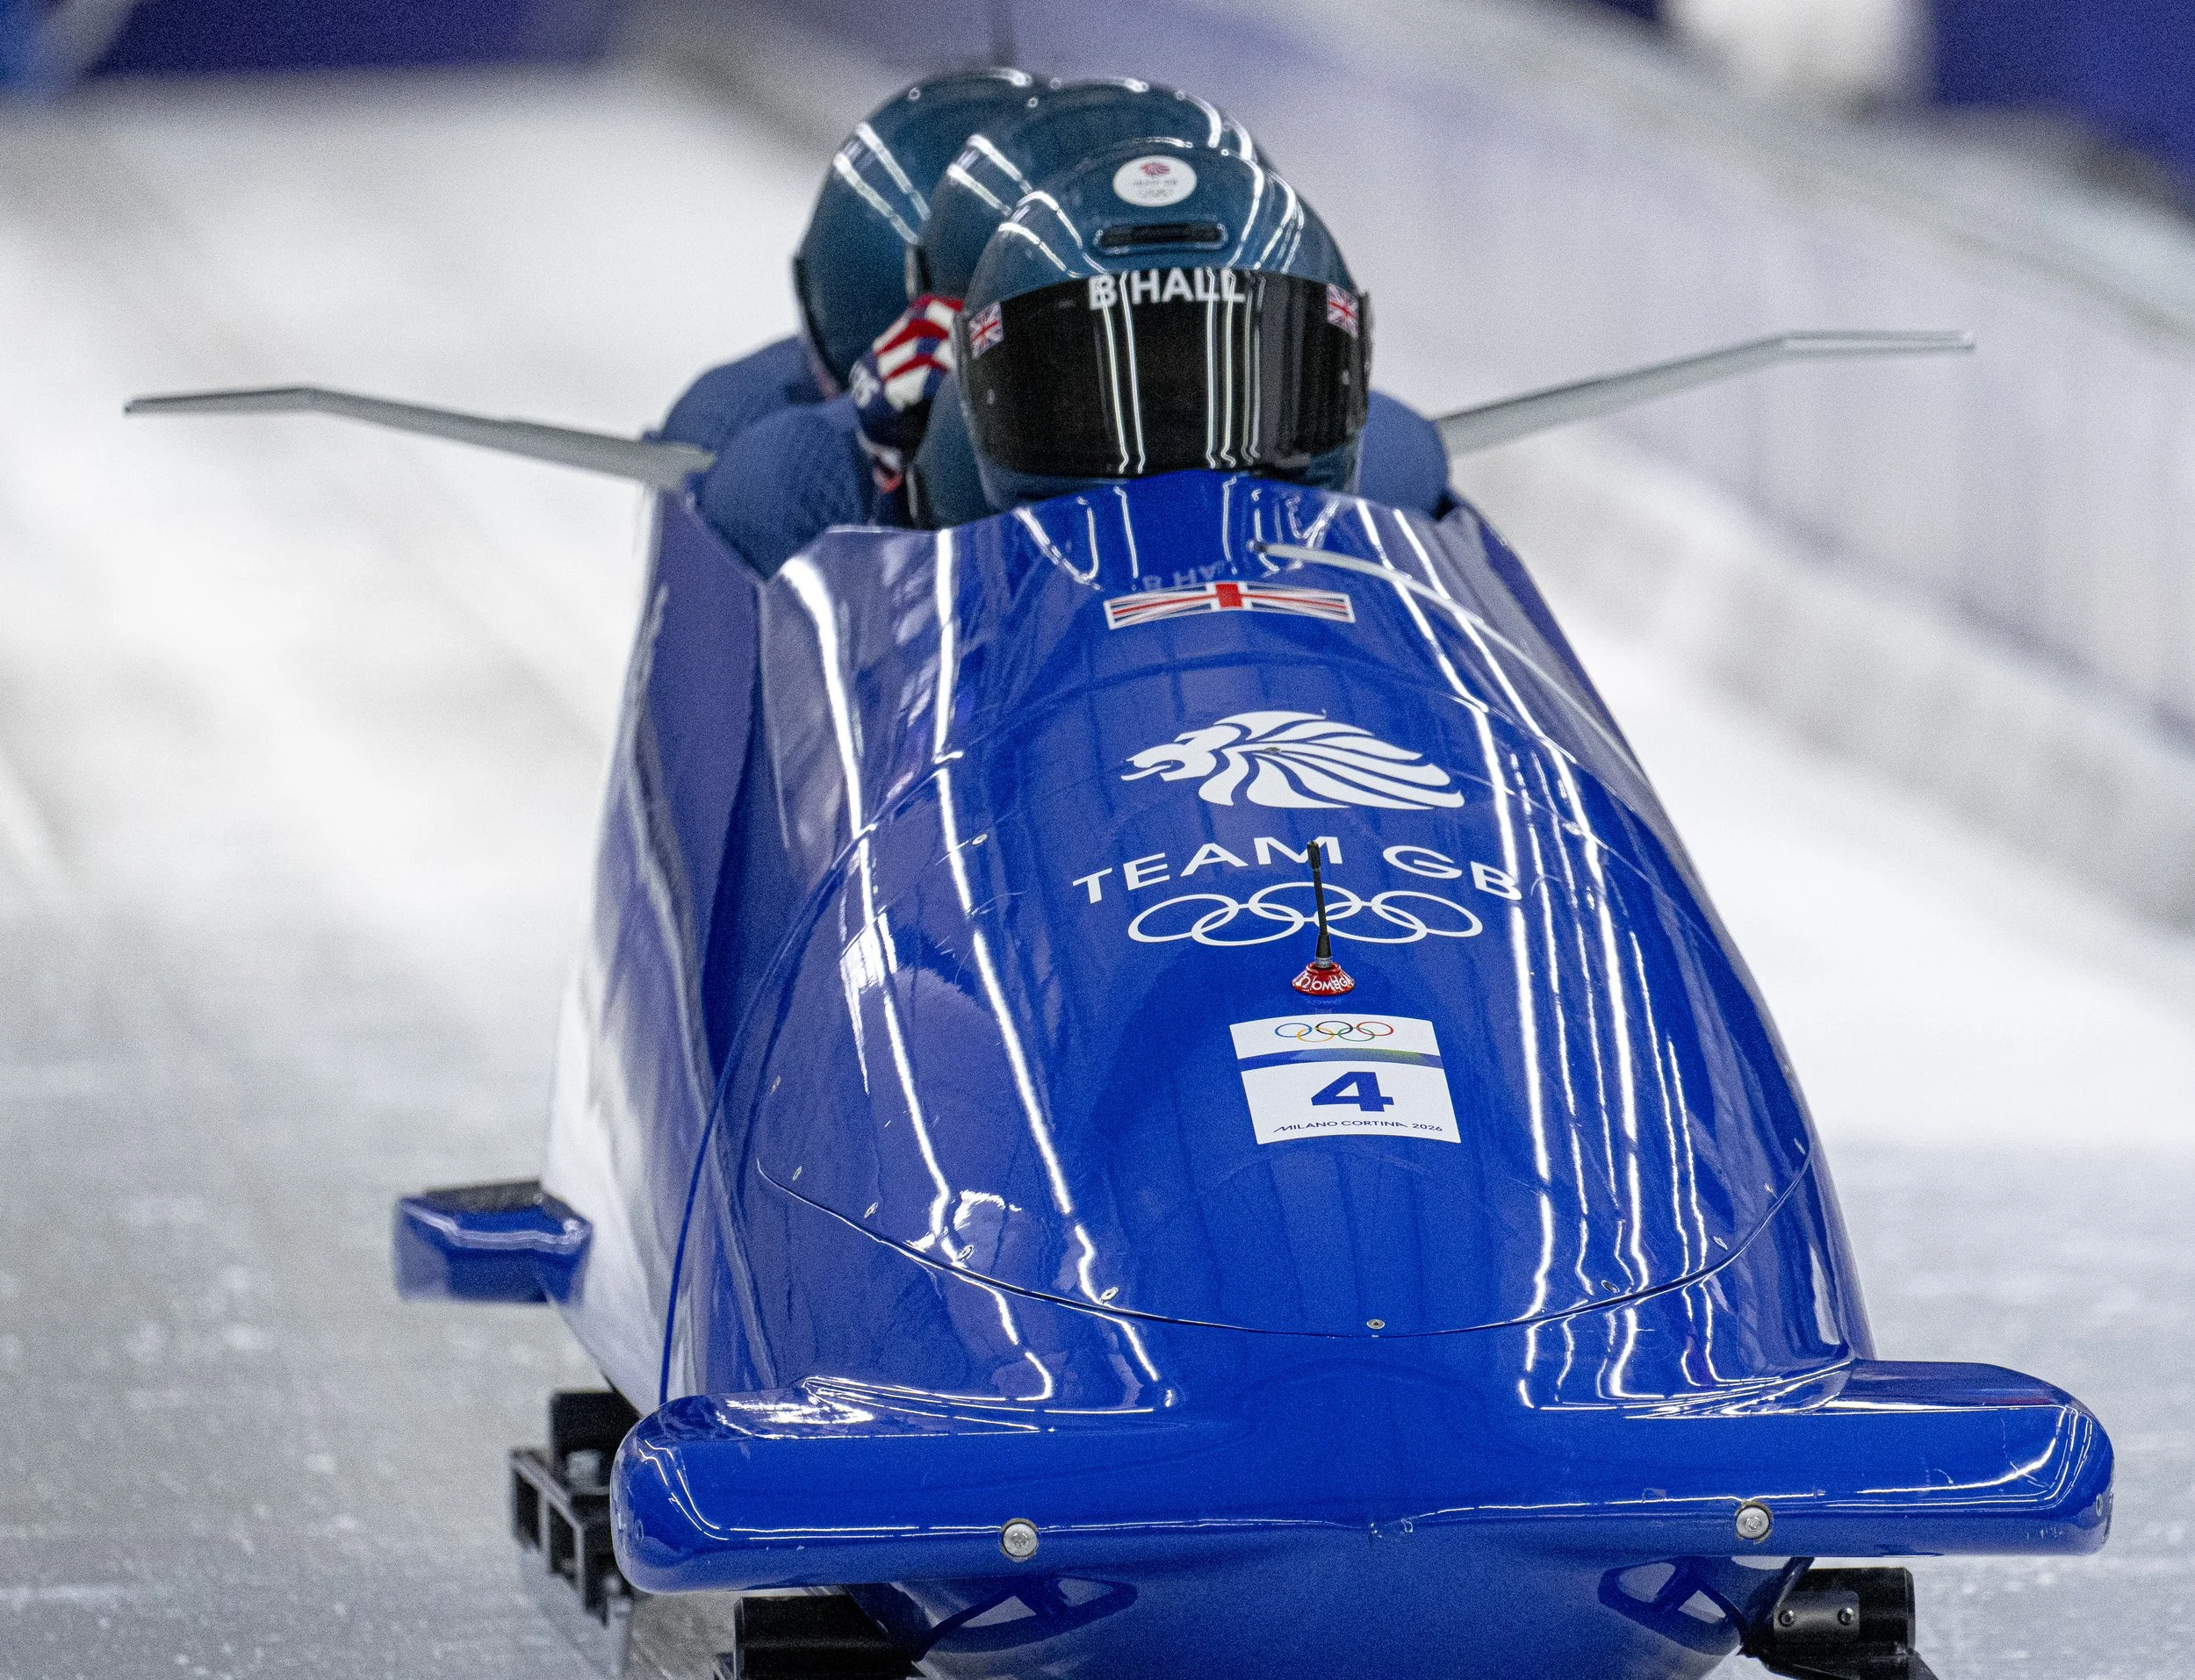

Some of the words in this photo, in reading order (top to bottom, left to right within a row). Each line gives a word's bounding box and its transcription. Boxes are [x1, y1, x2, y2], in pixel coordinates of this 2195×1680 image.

[1088, 275, 1118, 310] B
[1130, 267, 1247, 305] HALL
[1072, 836, 1343, 904] TEAM
[1383, 845, 1522, 901] GB
[1311, 1071, 1394, 1112] 4
[1273, 1121, 1338, 1132] MILANO
[1412, 1123, 1443, 1132] 2026
